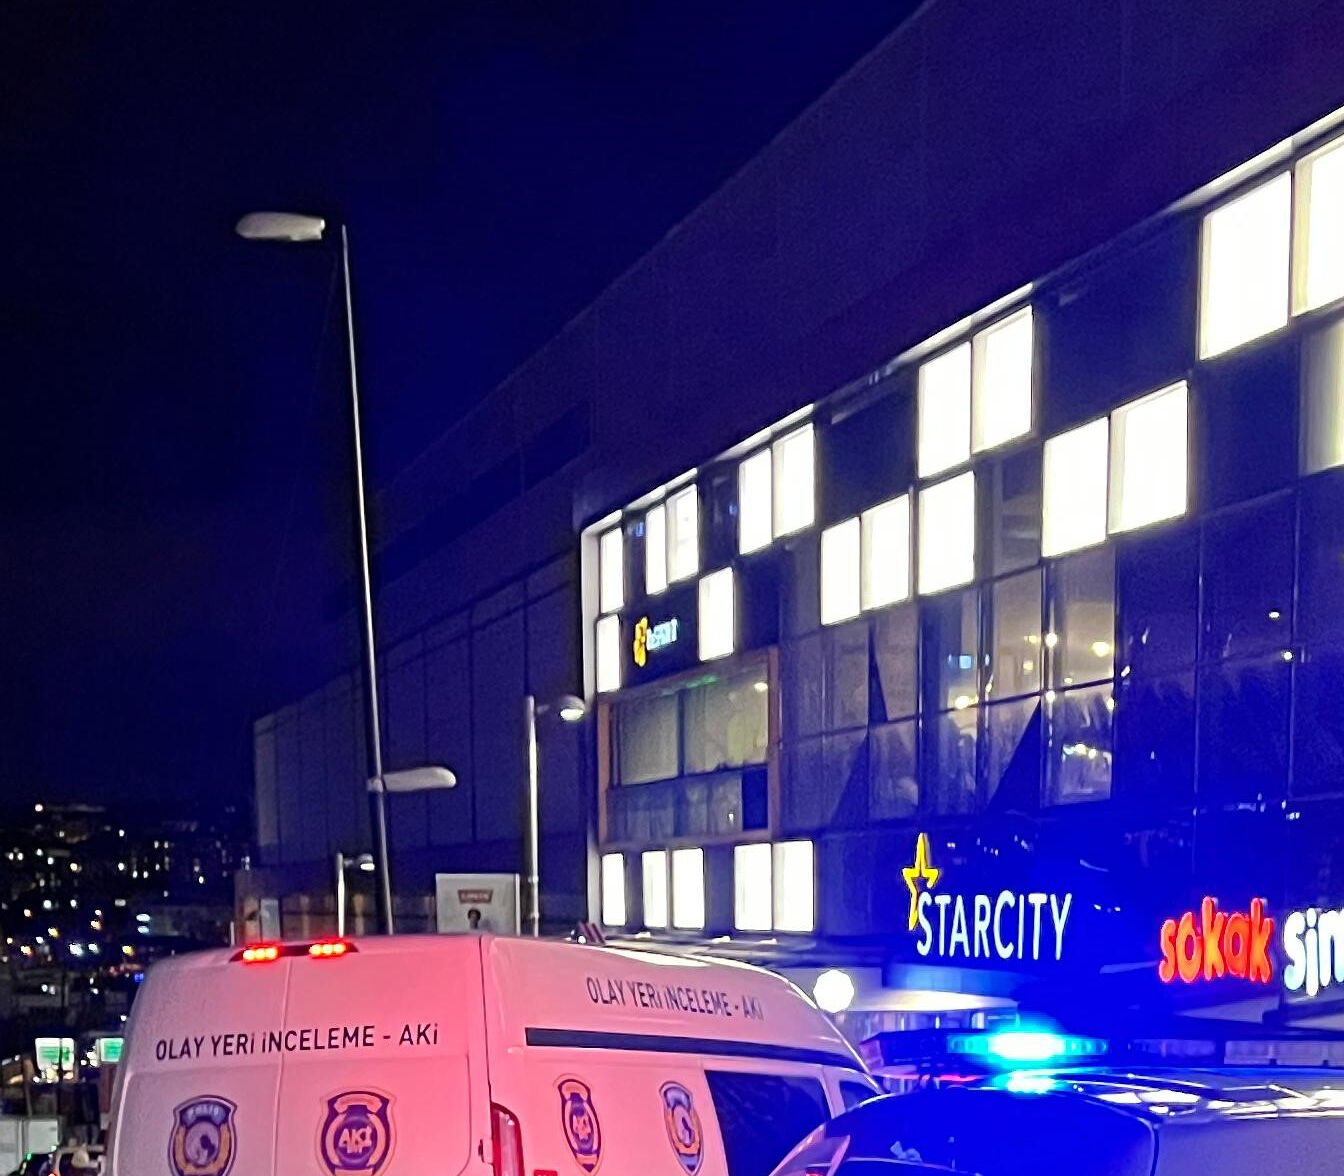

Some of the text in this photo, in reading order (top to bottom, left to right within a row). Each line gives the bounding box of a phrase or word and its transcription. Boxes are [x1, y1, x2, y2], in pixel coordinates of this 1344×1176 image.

[917, 889, 1073, 961] STARCITY
[1159, 896, 1275, 984] sokak
[586, 977, 627, 1007] OLAY
[156, 1035, 205, 1061] OLAY
